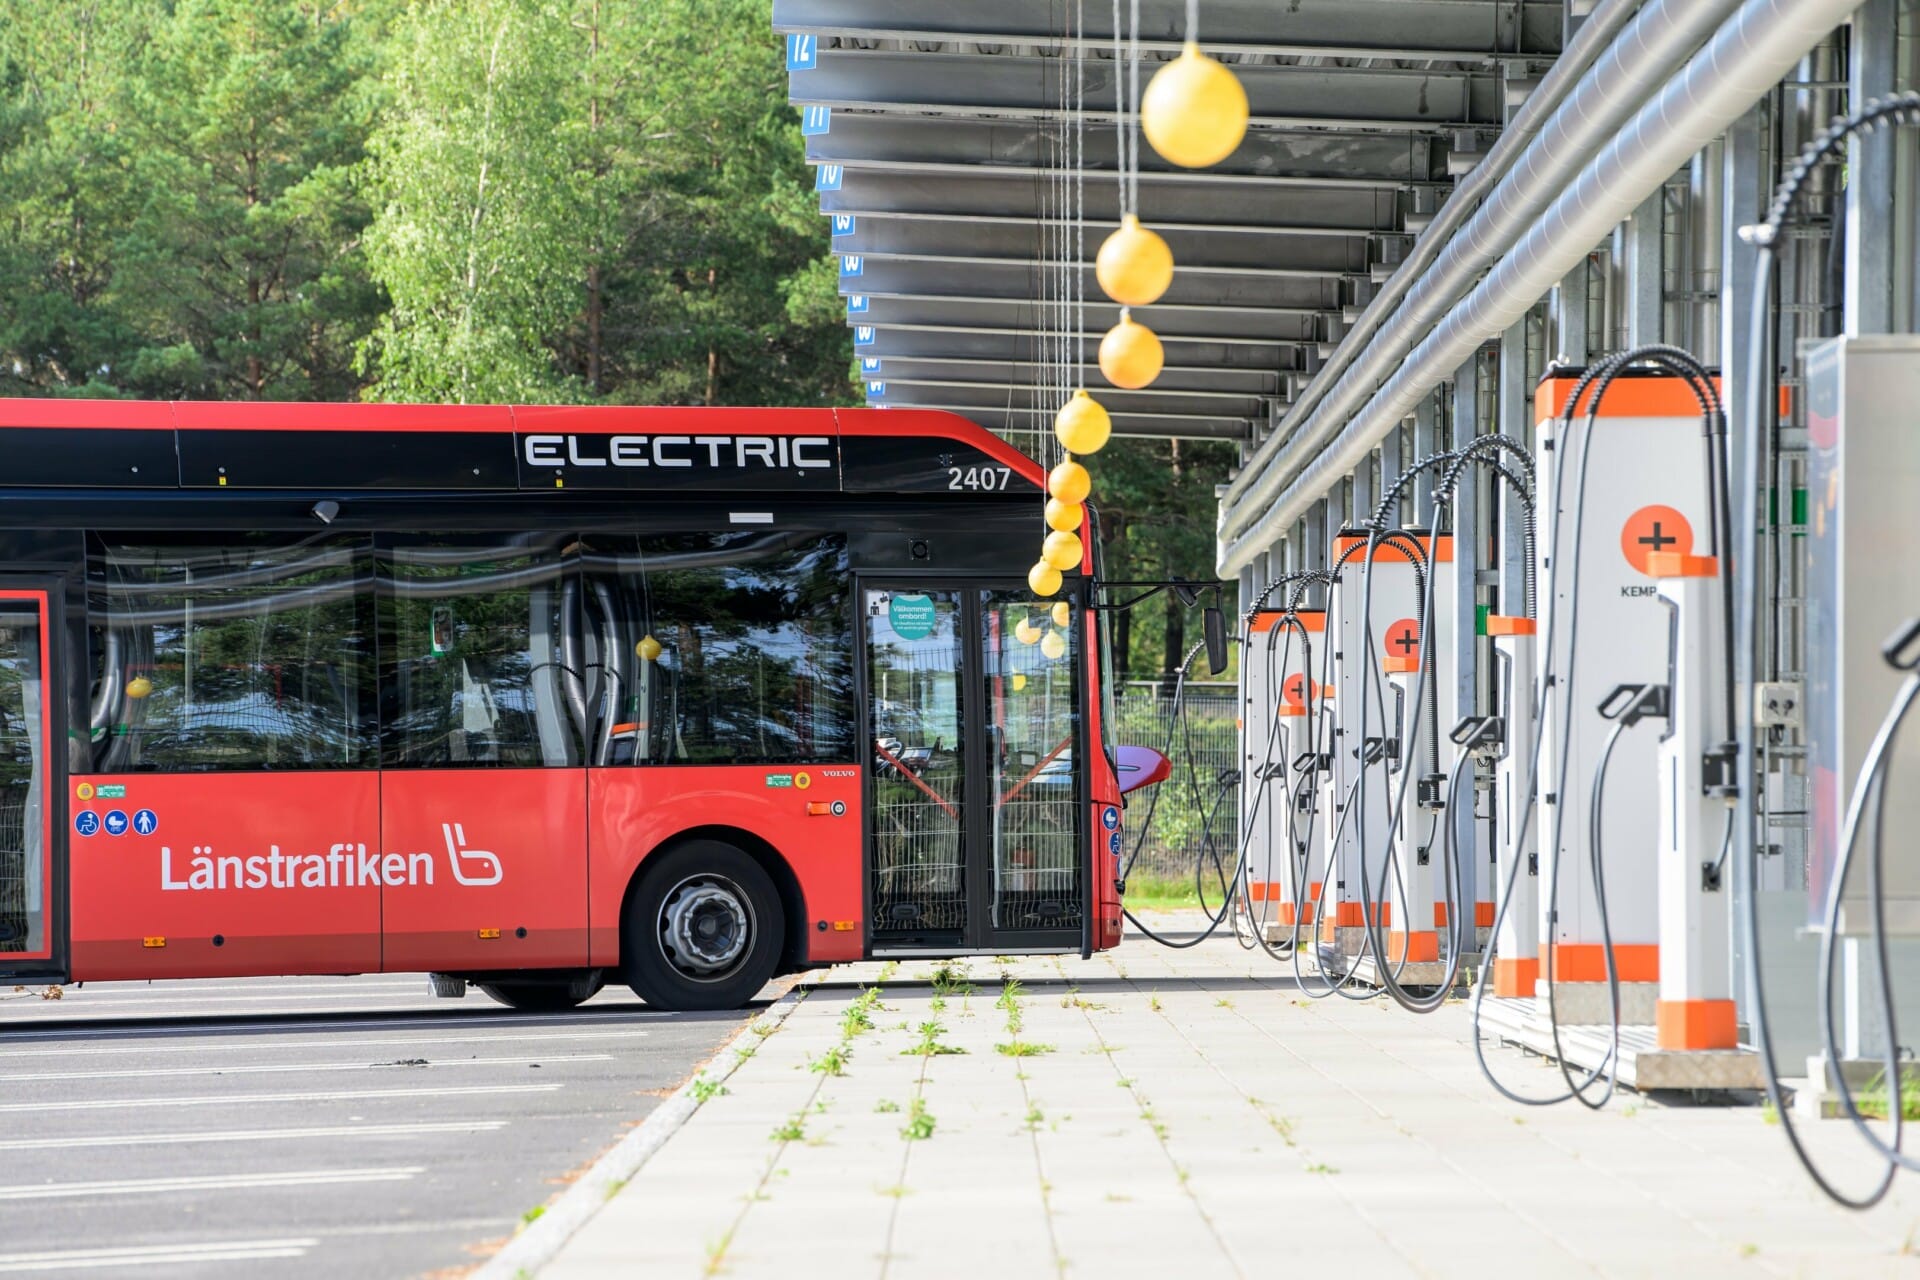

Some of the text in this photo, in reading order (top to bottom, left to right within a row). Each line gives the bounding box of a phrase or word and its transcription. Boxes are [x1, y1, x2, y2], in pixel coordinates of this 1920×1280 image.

[525, 435, 831, 468] ELECTRIC
[948, 466, 1011, 491] 2407
[893, 604, 932, 612] Välkommen
[162, 843, 434, 890] Länstrafiken
